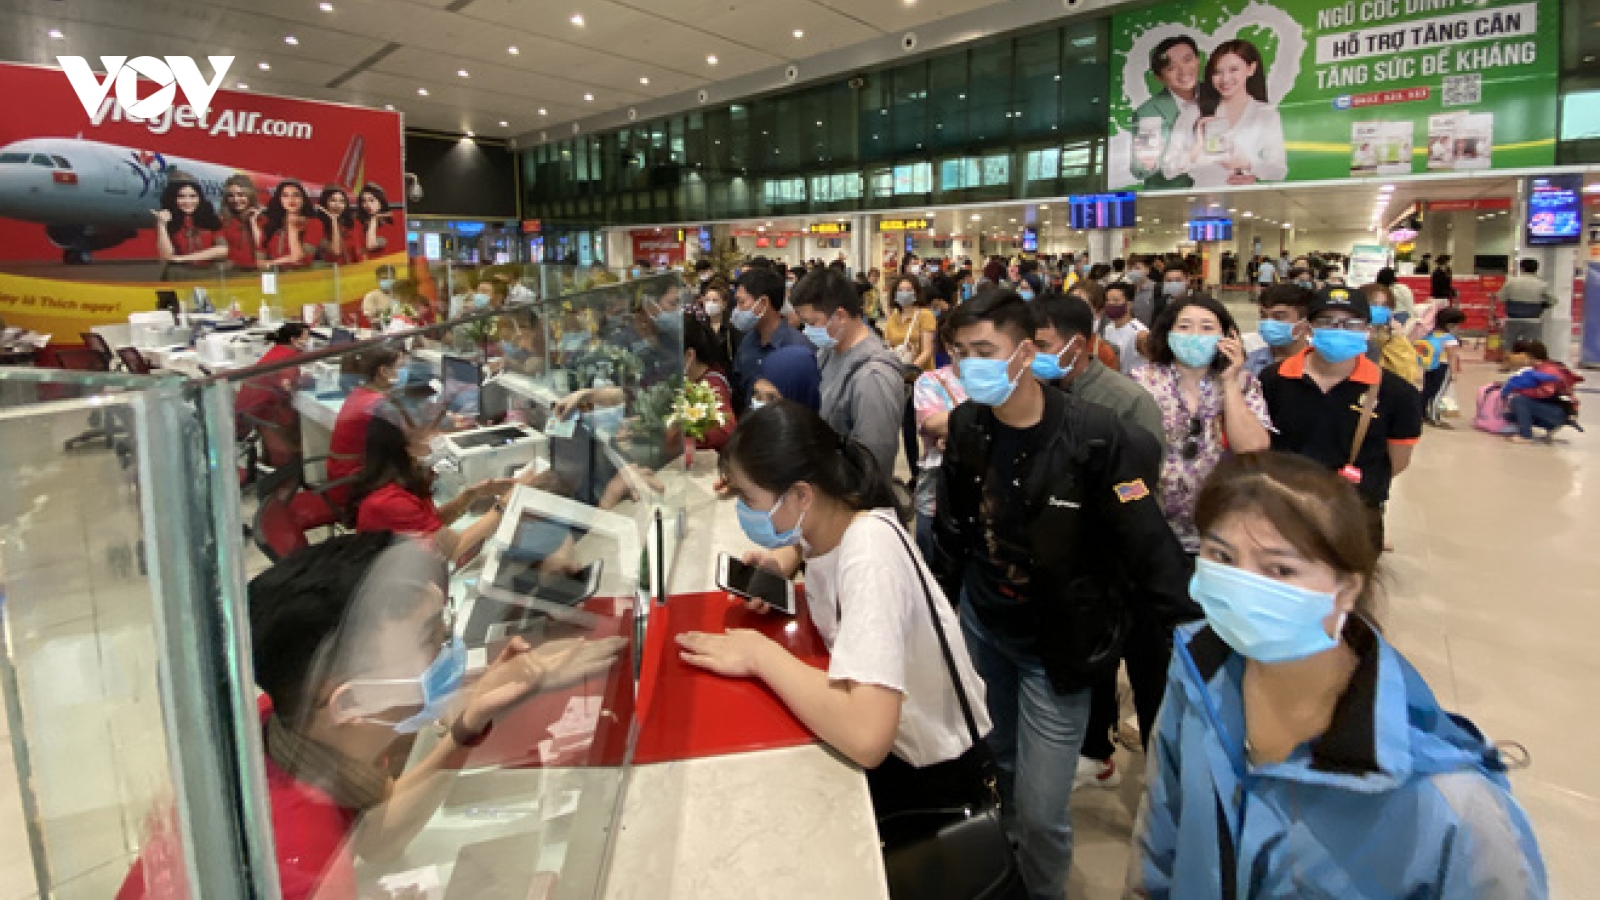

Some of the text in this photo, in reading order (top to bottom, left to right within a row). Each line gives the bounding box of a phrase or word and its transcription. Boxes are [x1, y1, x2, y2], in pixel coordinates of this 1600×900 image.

[1365, 29, 1406, 51] TRỢ
[1411, 21, 1467, 44] TĂNG
[1457, 41, 1535, 71] KHÁNG
